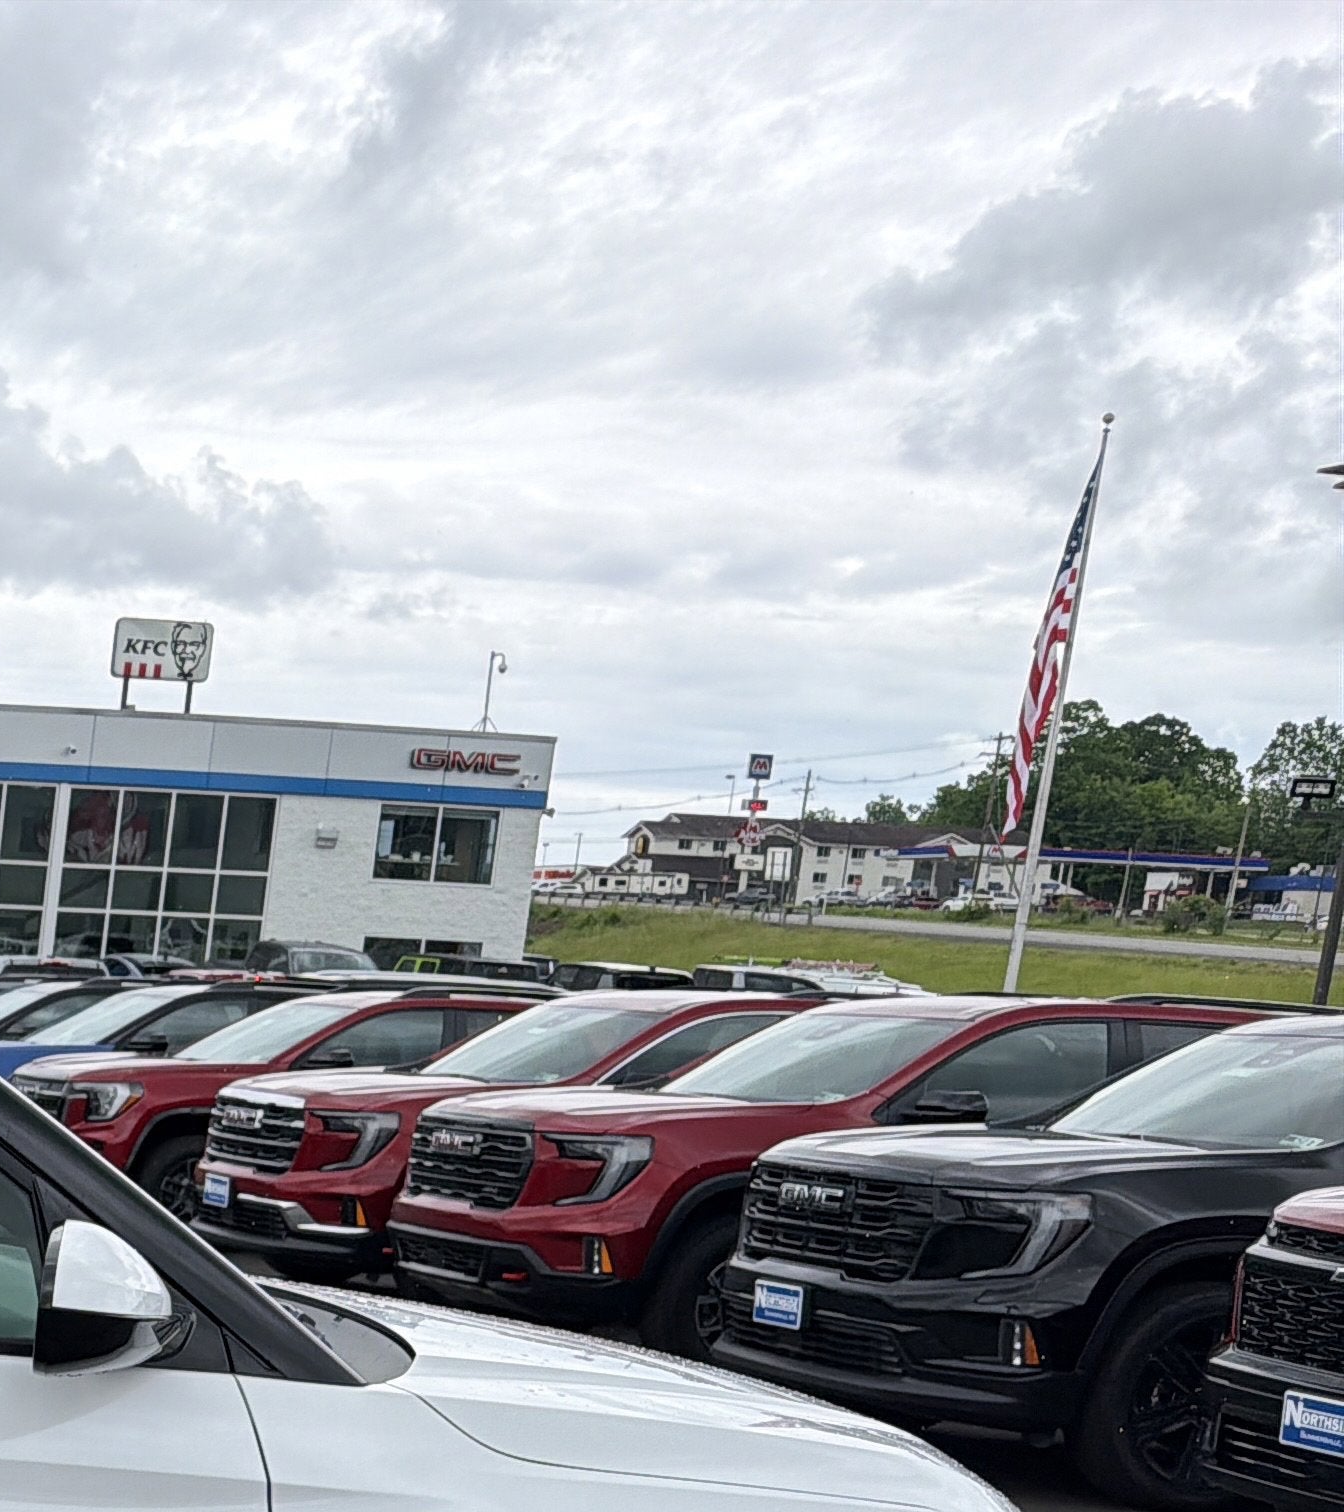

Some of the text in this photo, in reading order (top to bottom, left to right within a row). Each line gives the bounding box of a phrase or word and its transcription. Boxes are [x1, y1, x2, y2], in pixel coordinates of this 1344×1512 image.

[123, 638, 169, 657] KFC
[410, 748, 522, 776] GMC
[780, 1182, 844, 1210] GMC
